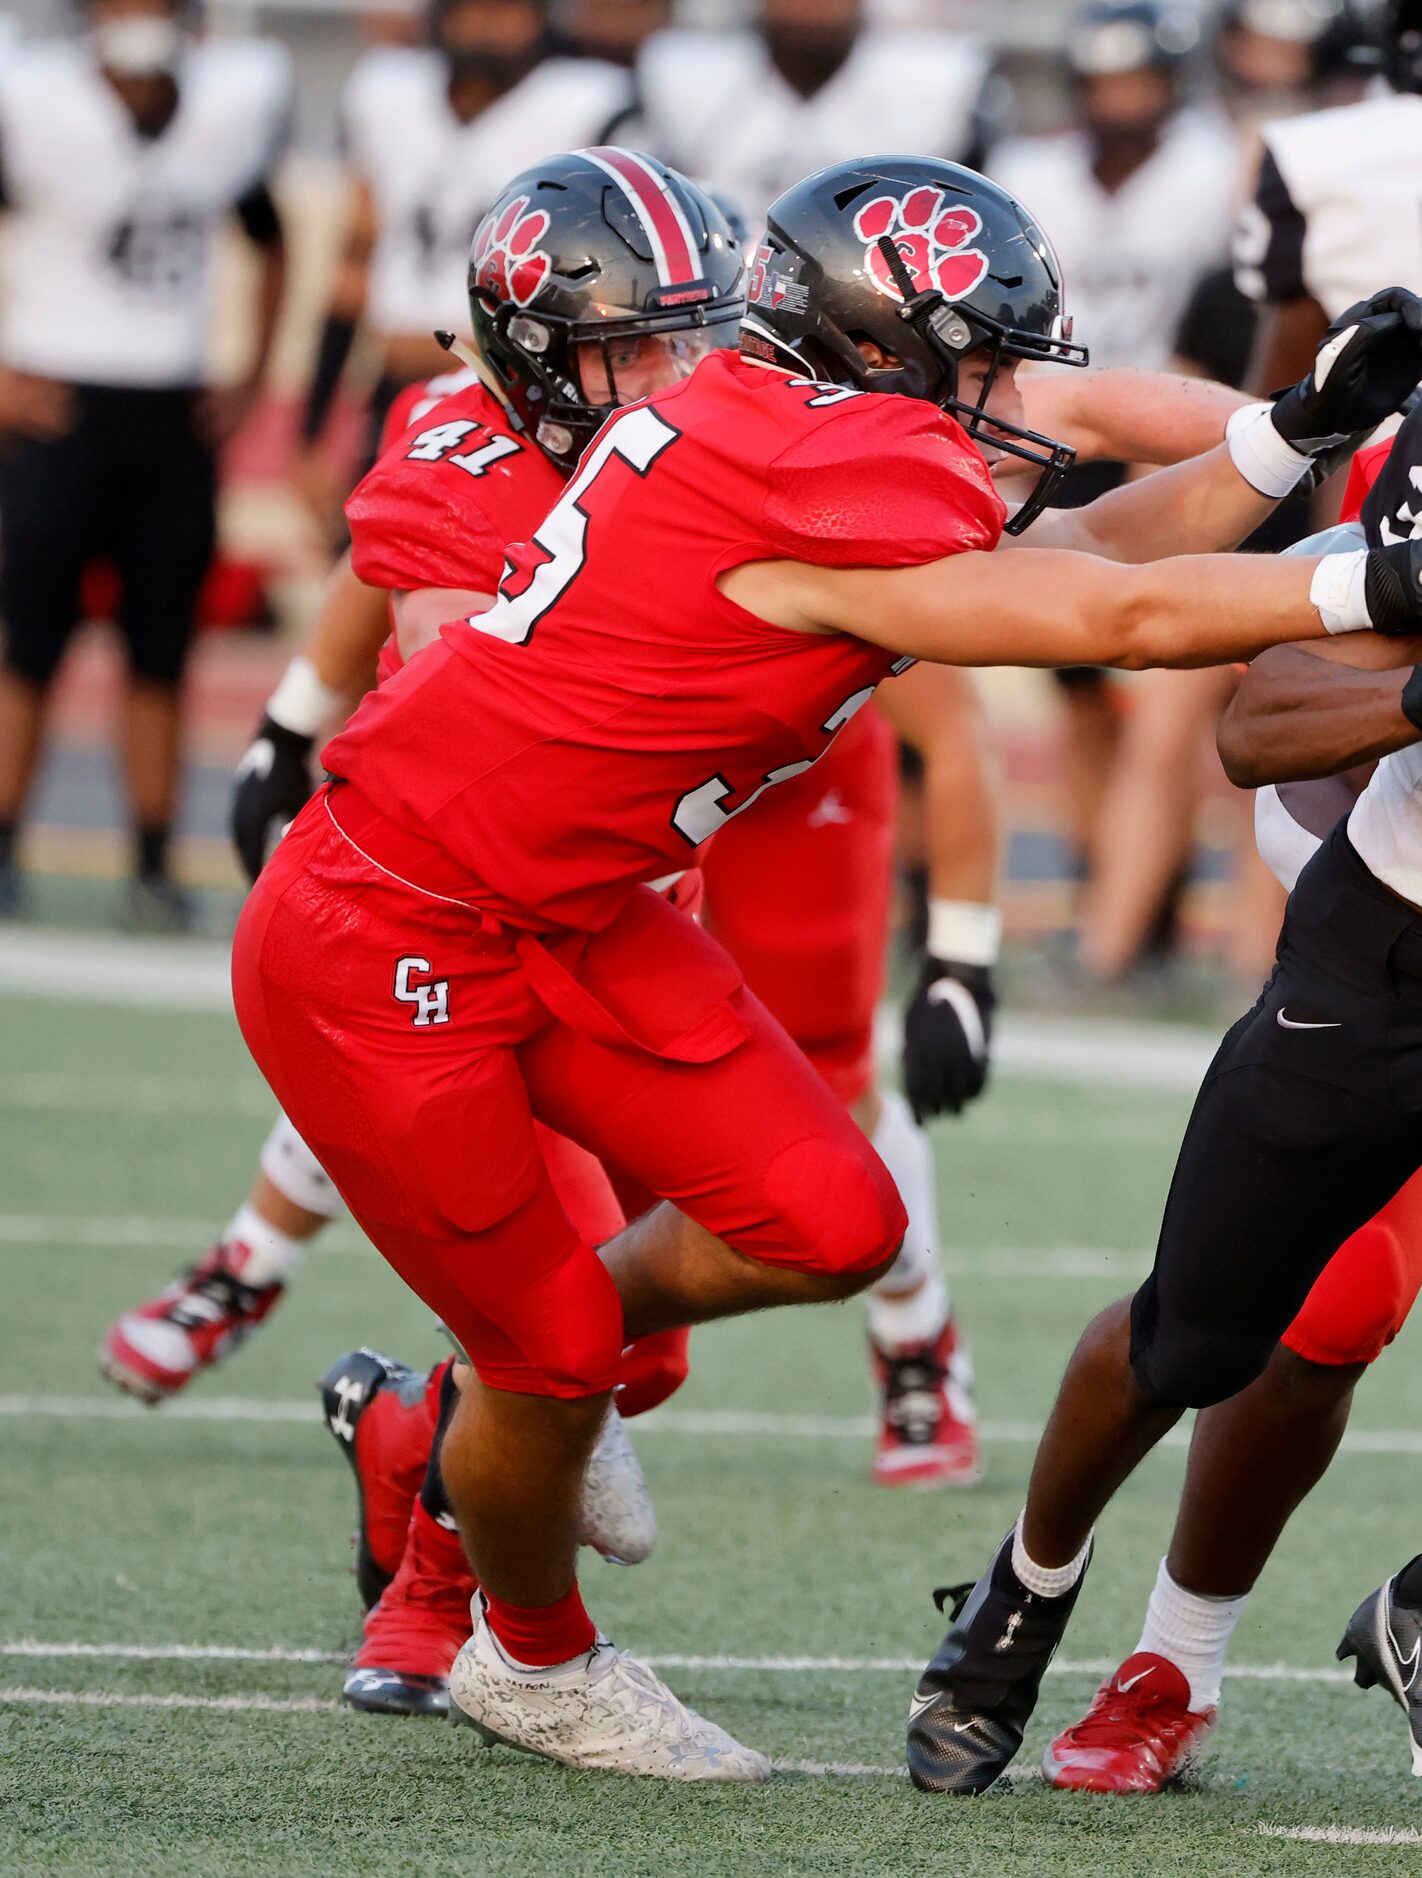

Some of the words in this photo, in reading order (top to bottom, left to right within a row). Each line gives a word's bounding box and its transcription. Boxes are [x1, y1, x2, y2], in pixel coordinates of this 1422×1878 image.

[747, 244, 775, 304] 5
[405, 418, 524, 479] 41
[393, 956, 450, 1026] CH
